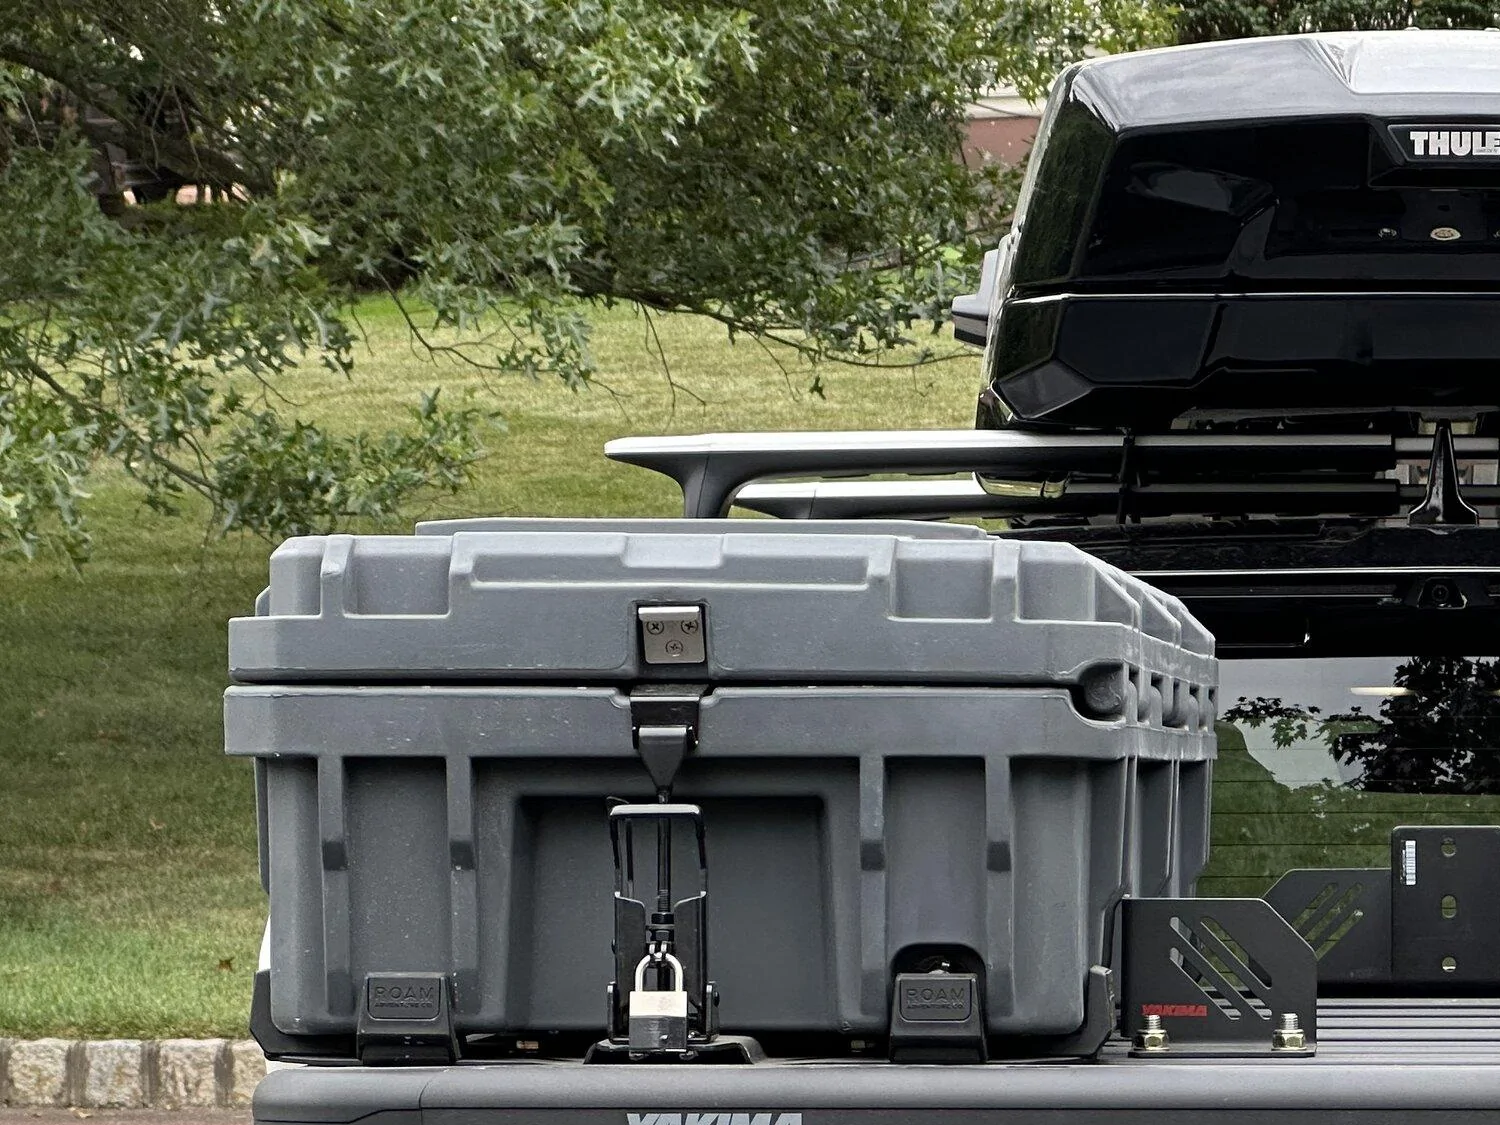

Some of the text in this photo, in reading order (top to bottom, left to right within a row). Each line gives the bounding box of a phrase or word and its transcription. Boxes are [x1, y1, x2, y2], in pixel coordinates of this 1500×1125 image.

[374, 986, 434, 999] ROAM
[906, 987, 965, 1000] ROAM
[1142, 1004, 1208, 1017] YAKIMA
